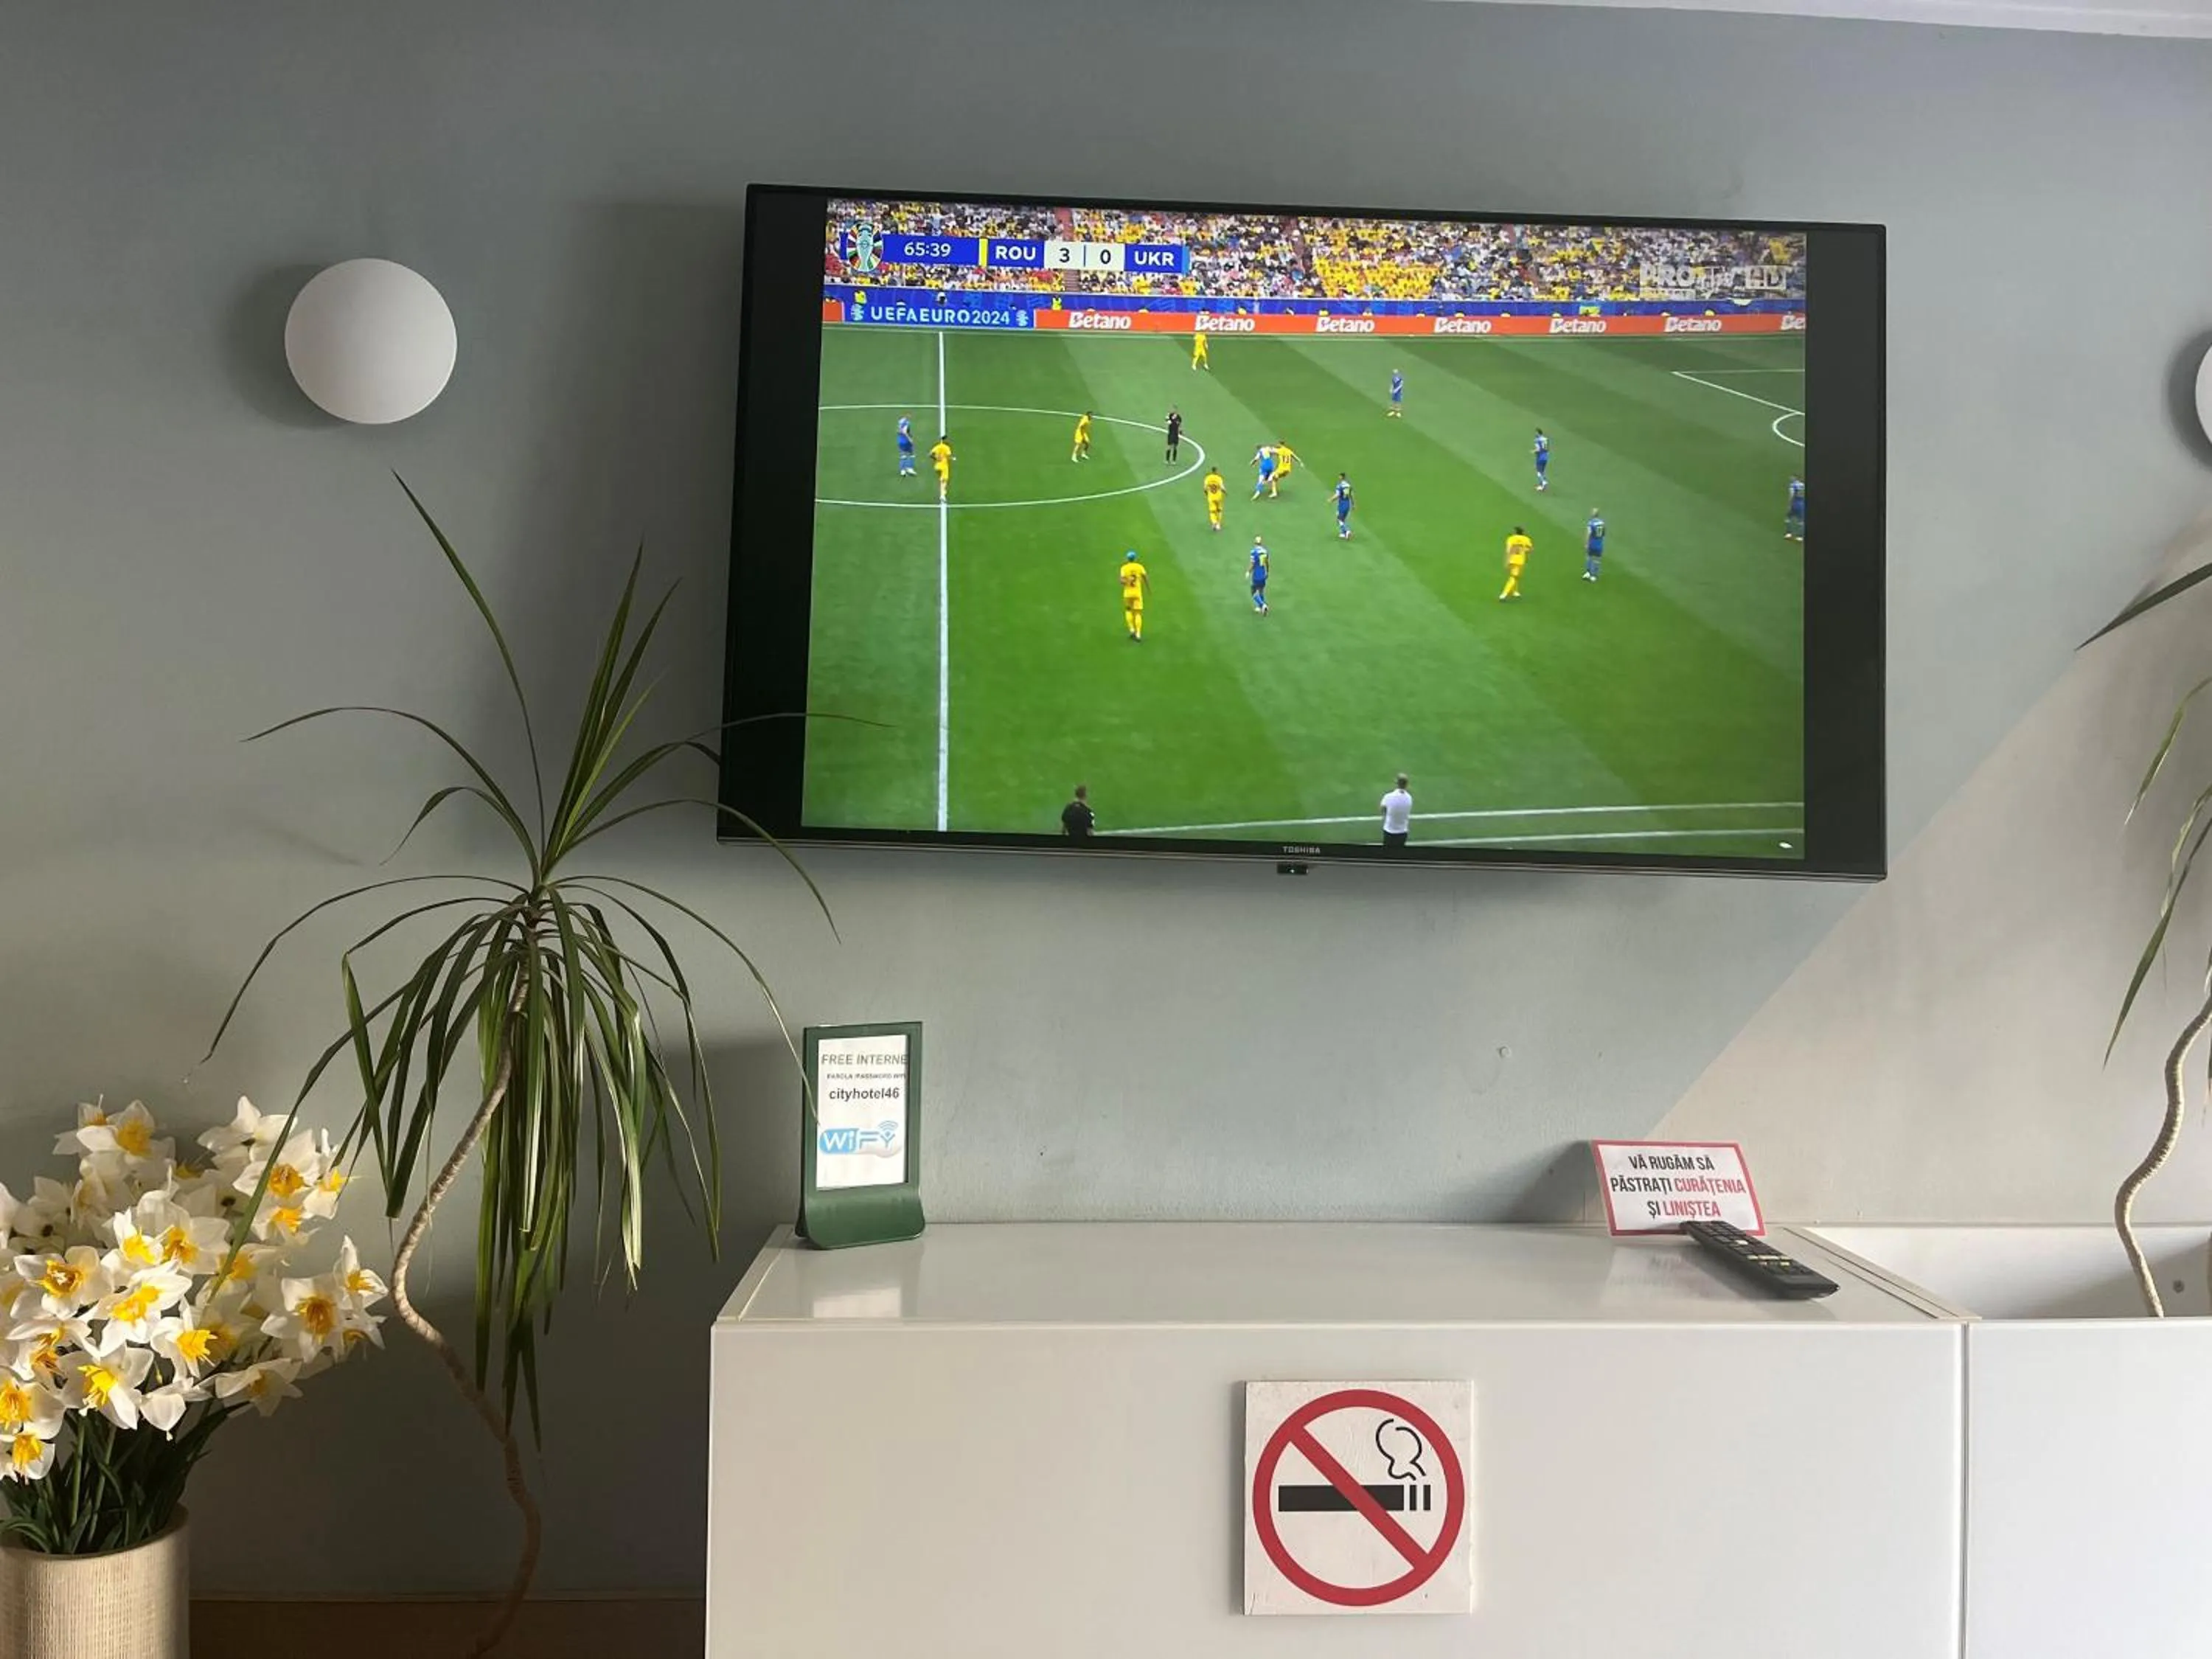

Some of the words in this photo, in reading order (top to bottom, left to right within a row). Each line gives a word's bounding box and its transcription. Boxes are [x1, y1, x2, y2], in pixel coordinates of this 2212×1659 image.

[904, 242, 951, 257] 65:39
[995, 246, 1036, 260] ROU
[1059, 248, 1070, 262] 3
[1100, 249, 1111, 264] 0
[1134, 251, 1175, 266] UKR
[1068, 311, 1132, 330] Betano
[1194, 314, 1255, 331] Betano
[1315, 316, 1374, 332] Betano
[1433, 317, 1492, 333] Betano
[1549, 318, 1607, 333] Betano
[1663, 317, 1722, 333] Betano
[1283, 846, 1321, 854] TOSHIBA
[821, 1054, 853, 1065] FREE
[829, 1087, 900, 1102] cityhotel46
[1628, 1154, 1647, 1169] VĂ
[1649, 1154, 1694, 1170] RUGĂM
[1696, 1155, 1714, 1171] SĂ
[1610, 1175, 1672, 1194] PĂSTRAȚI
[1674, 1175, 1746, 1195] CURĂȚENIA
[1664, 1201, 1721, 1219] LINIȘTEA
